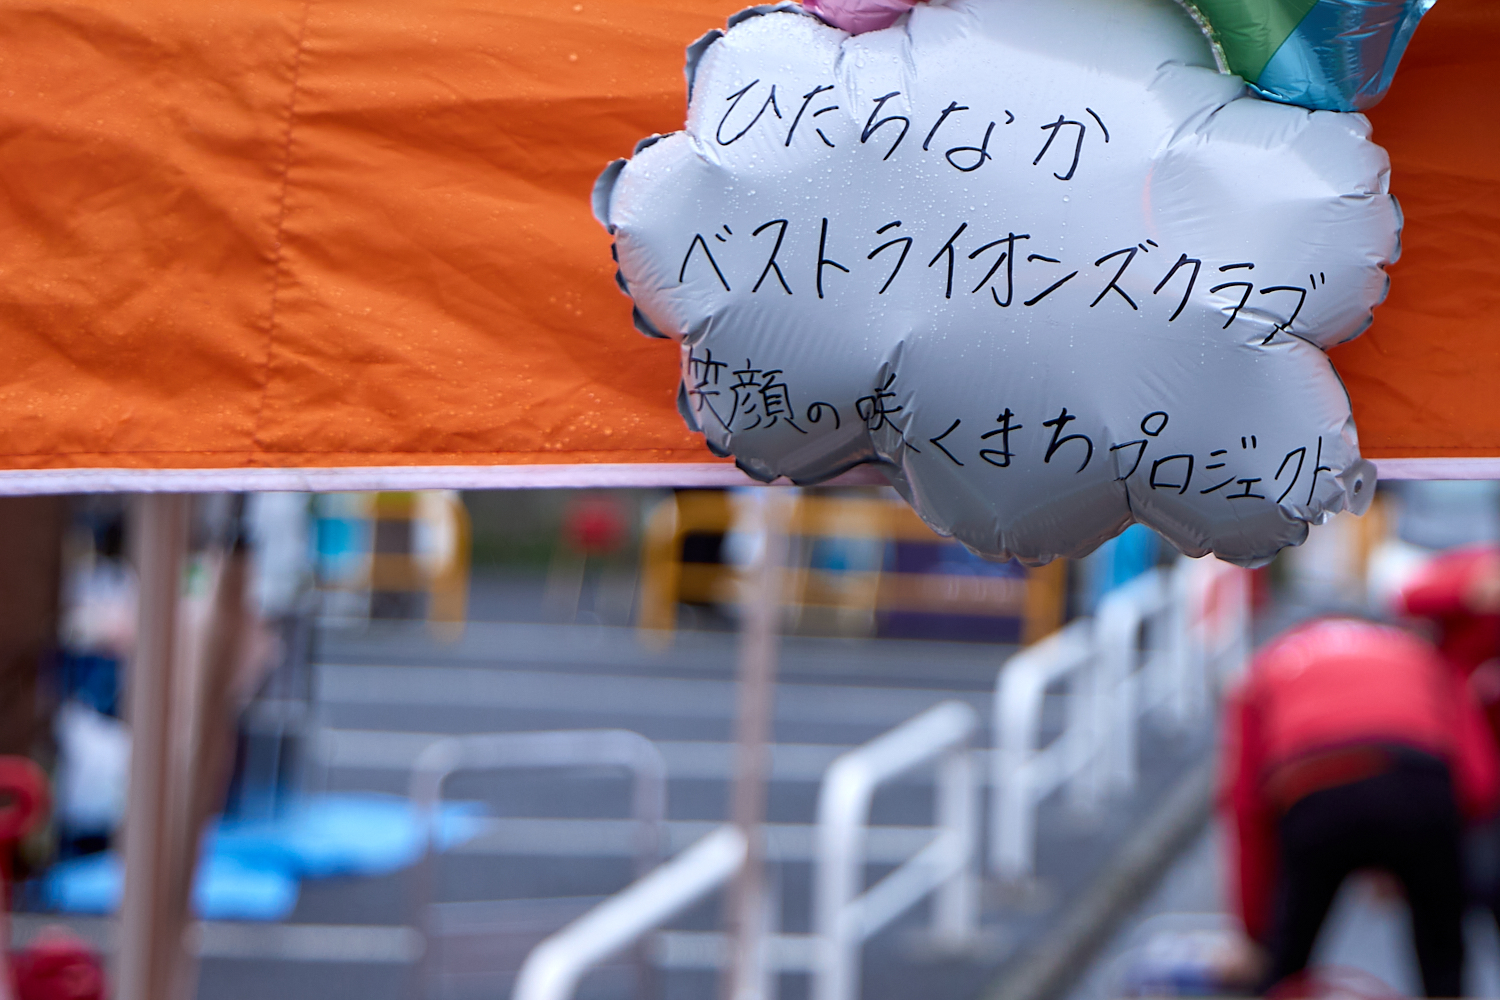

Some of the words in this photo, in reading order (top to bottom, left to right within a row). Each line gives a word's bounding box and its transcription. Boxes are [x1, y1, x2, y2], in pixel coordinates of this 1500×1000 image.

[715, 78, 1110, 181] ひたちなか
[677, 217, 1326, 346] ベストライオンズクラブ
[687, 345, 1332, 507] 笑顔の咲くまちプロジェクト
